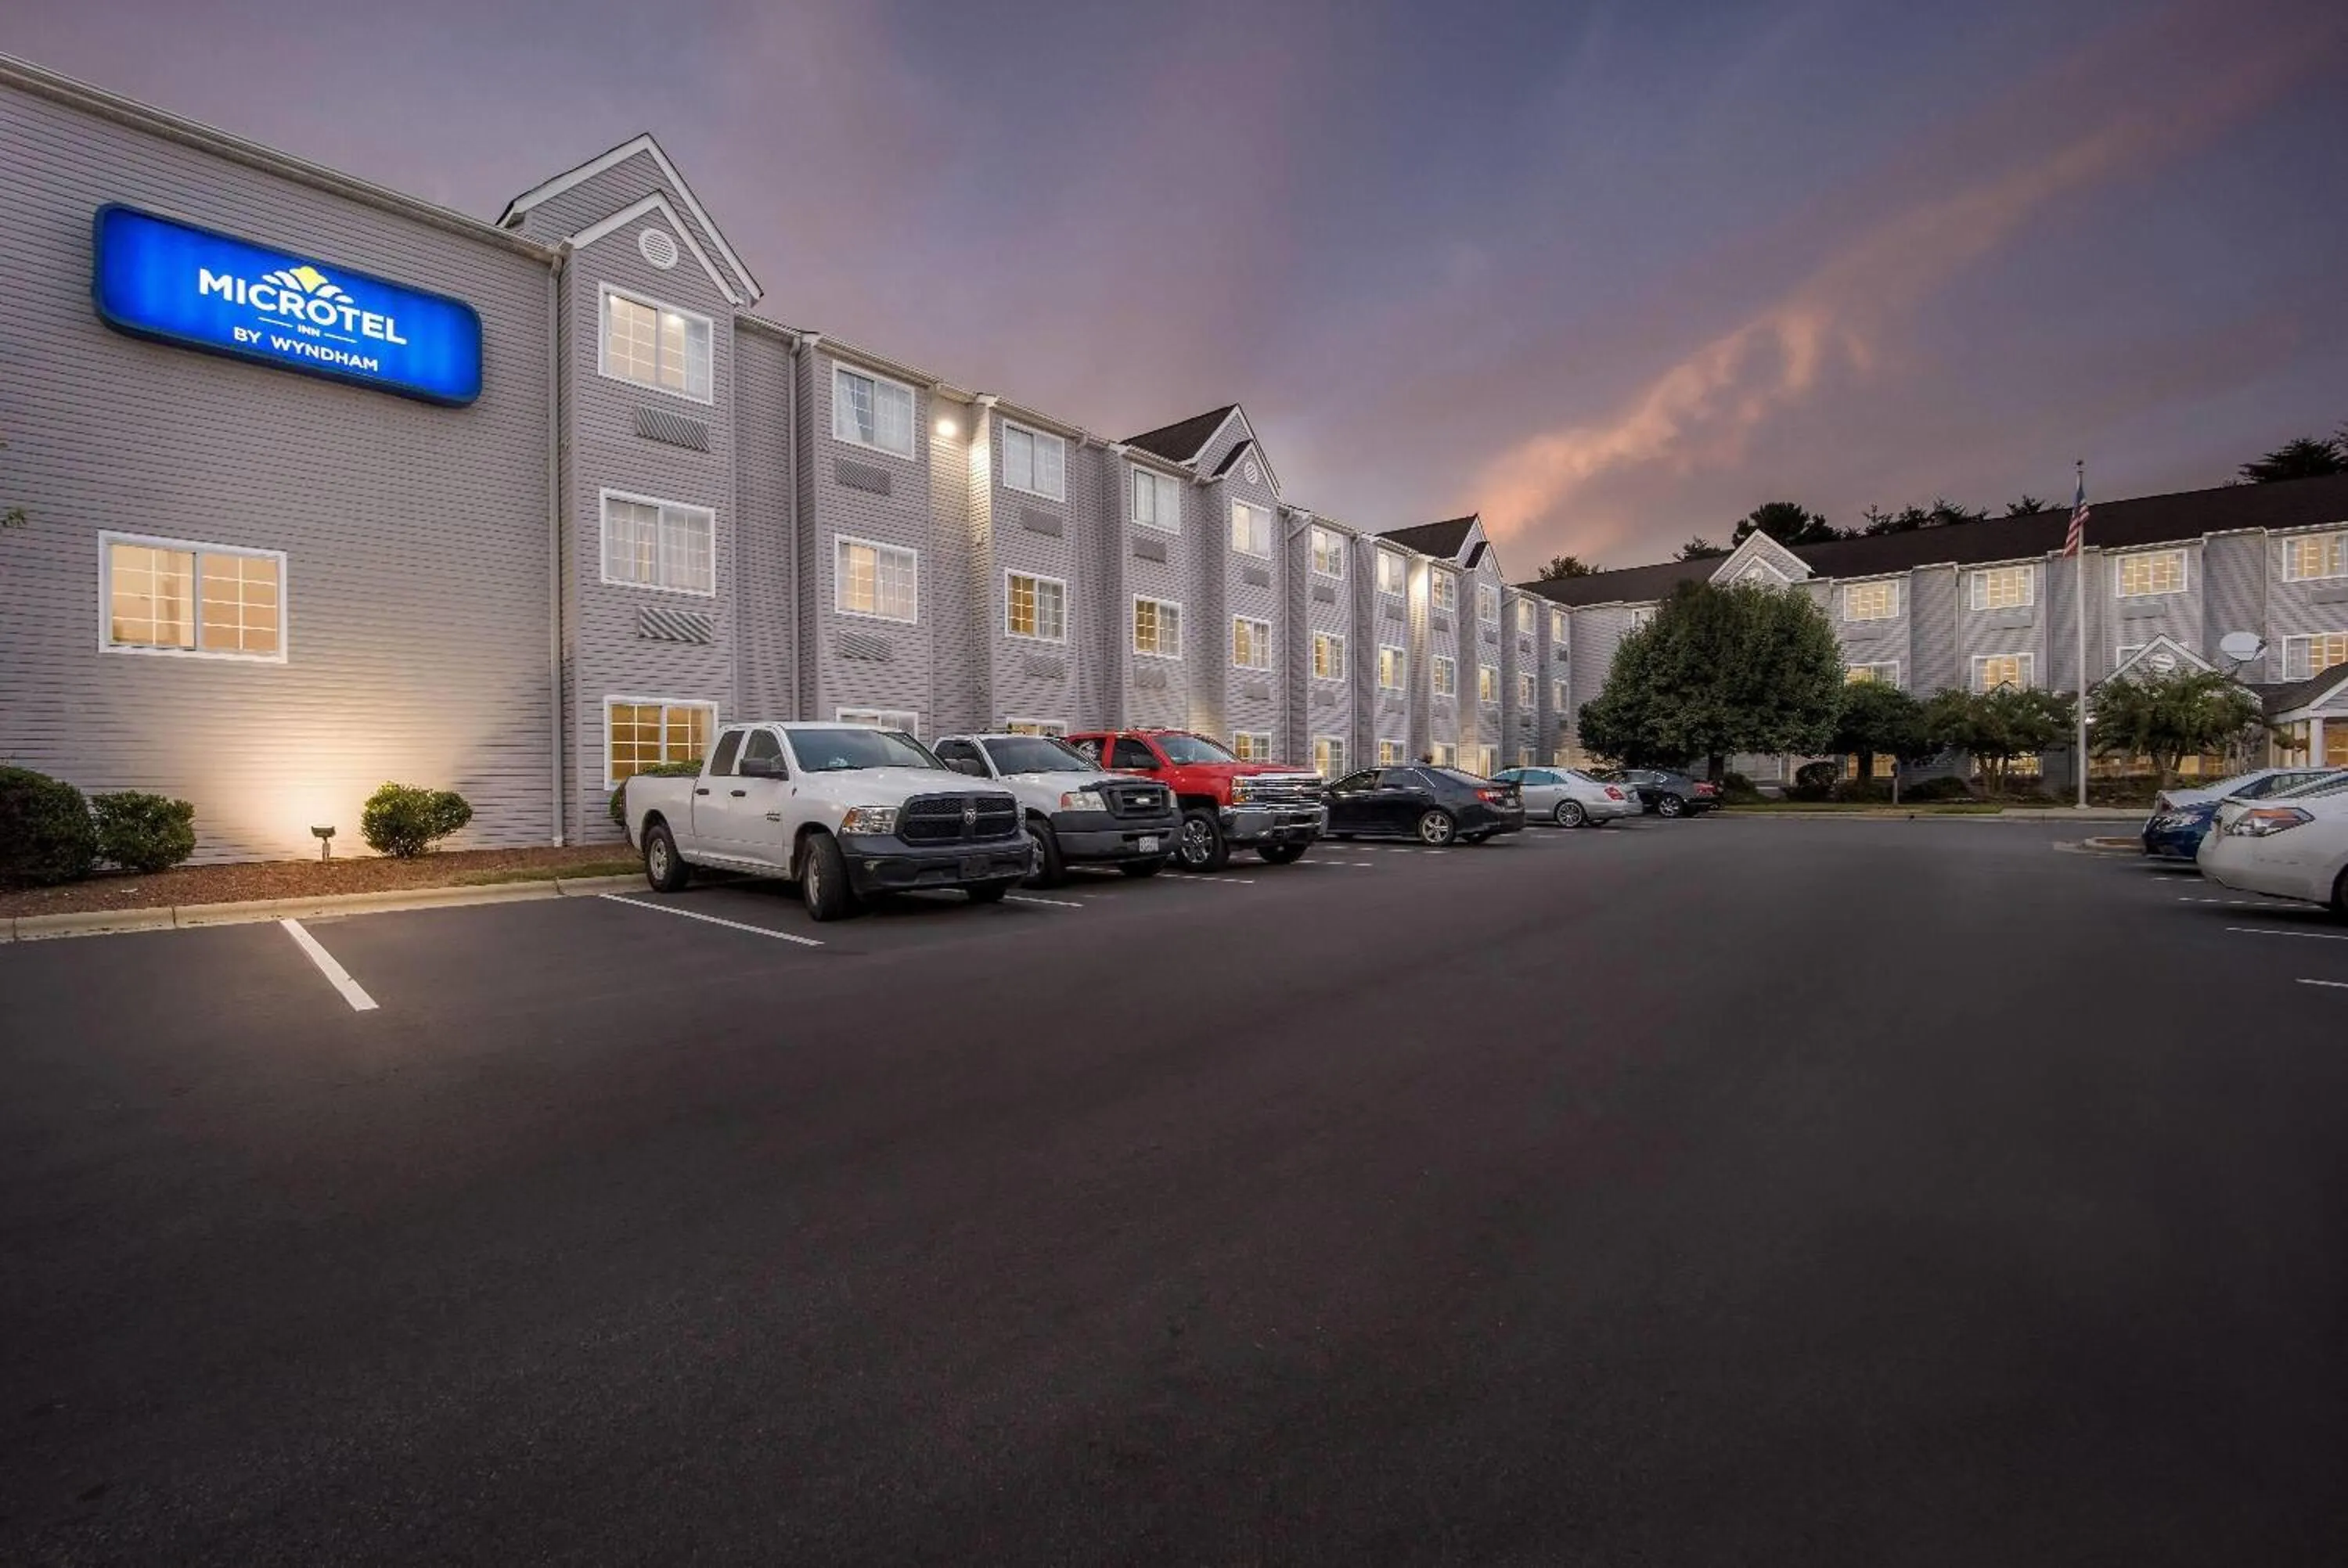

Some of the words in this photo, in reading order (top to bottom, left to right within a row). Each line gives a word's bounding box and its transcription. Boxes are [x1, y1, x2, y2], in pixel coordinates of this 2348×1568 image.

[199, 268, 408, 345] MICROTEL
[233, 326, 262, 343] BY
[271, 334, 379, 372] WYNDHAM
[297, 324, 321, 337] INN
